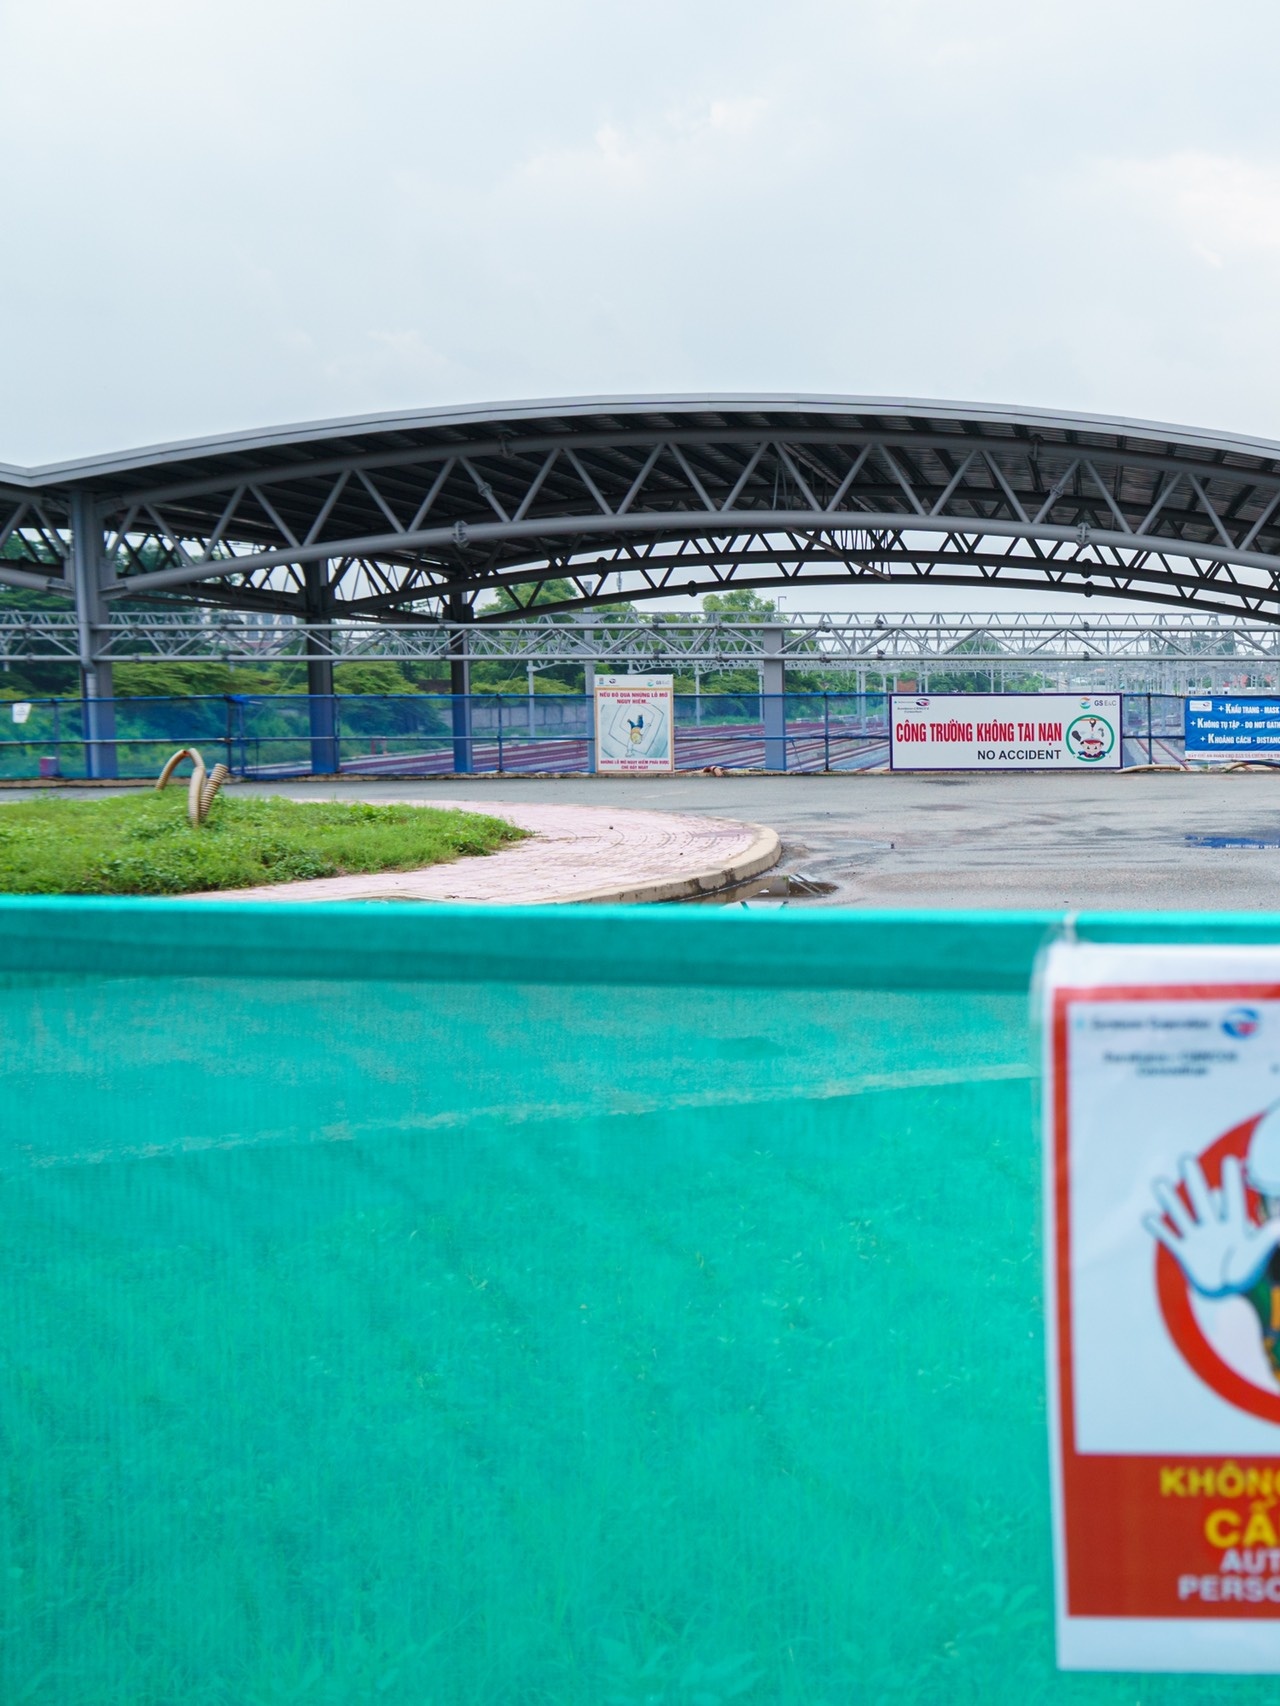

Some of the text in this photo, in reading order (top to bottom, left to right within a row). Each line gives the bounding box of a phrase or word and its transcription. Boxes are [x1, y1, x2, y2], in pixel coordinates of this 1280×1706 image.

[896, 719, 1062, 746] CÔNG TRƯỜNG KHÔNG TAI NẠN
[977, 750, 1062, 760] NO ACCIDENT
